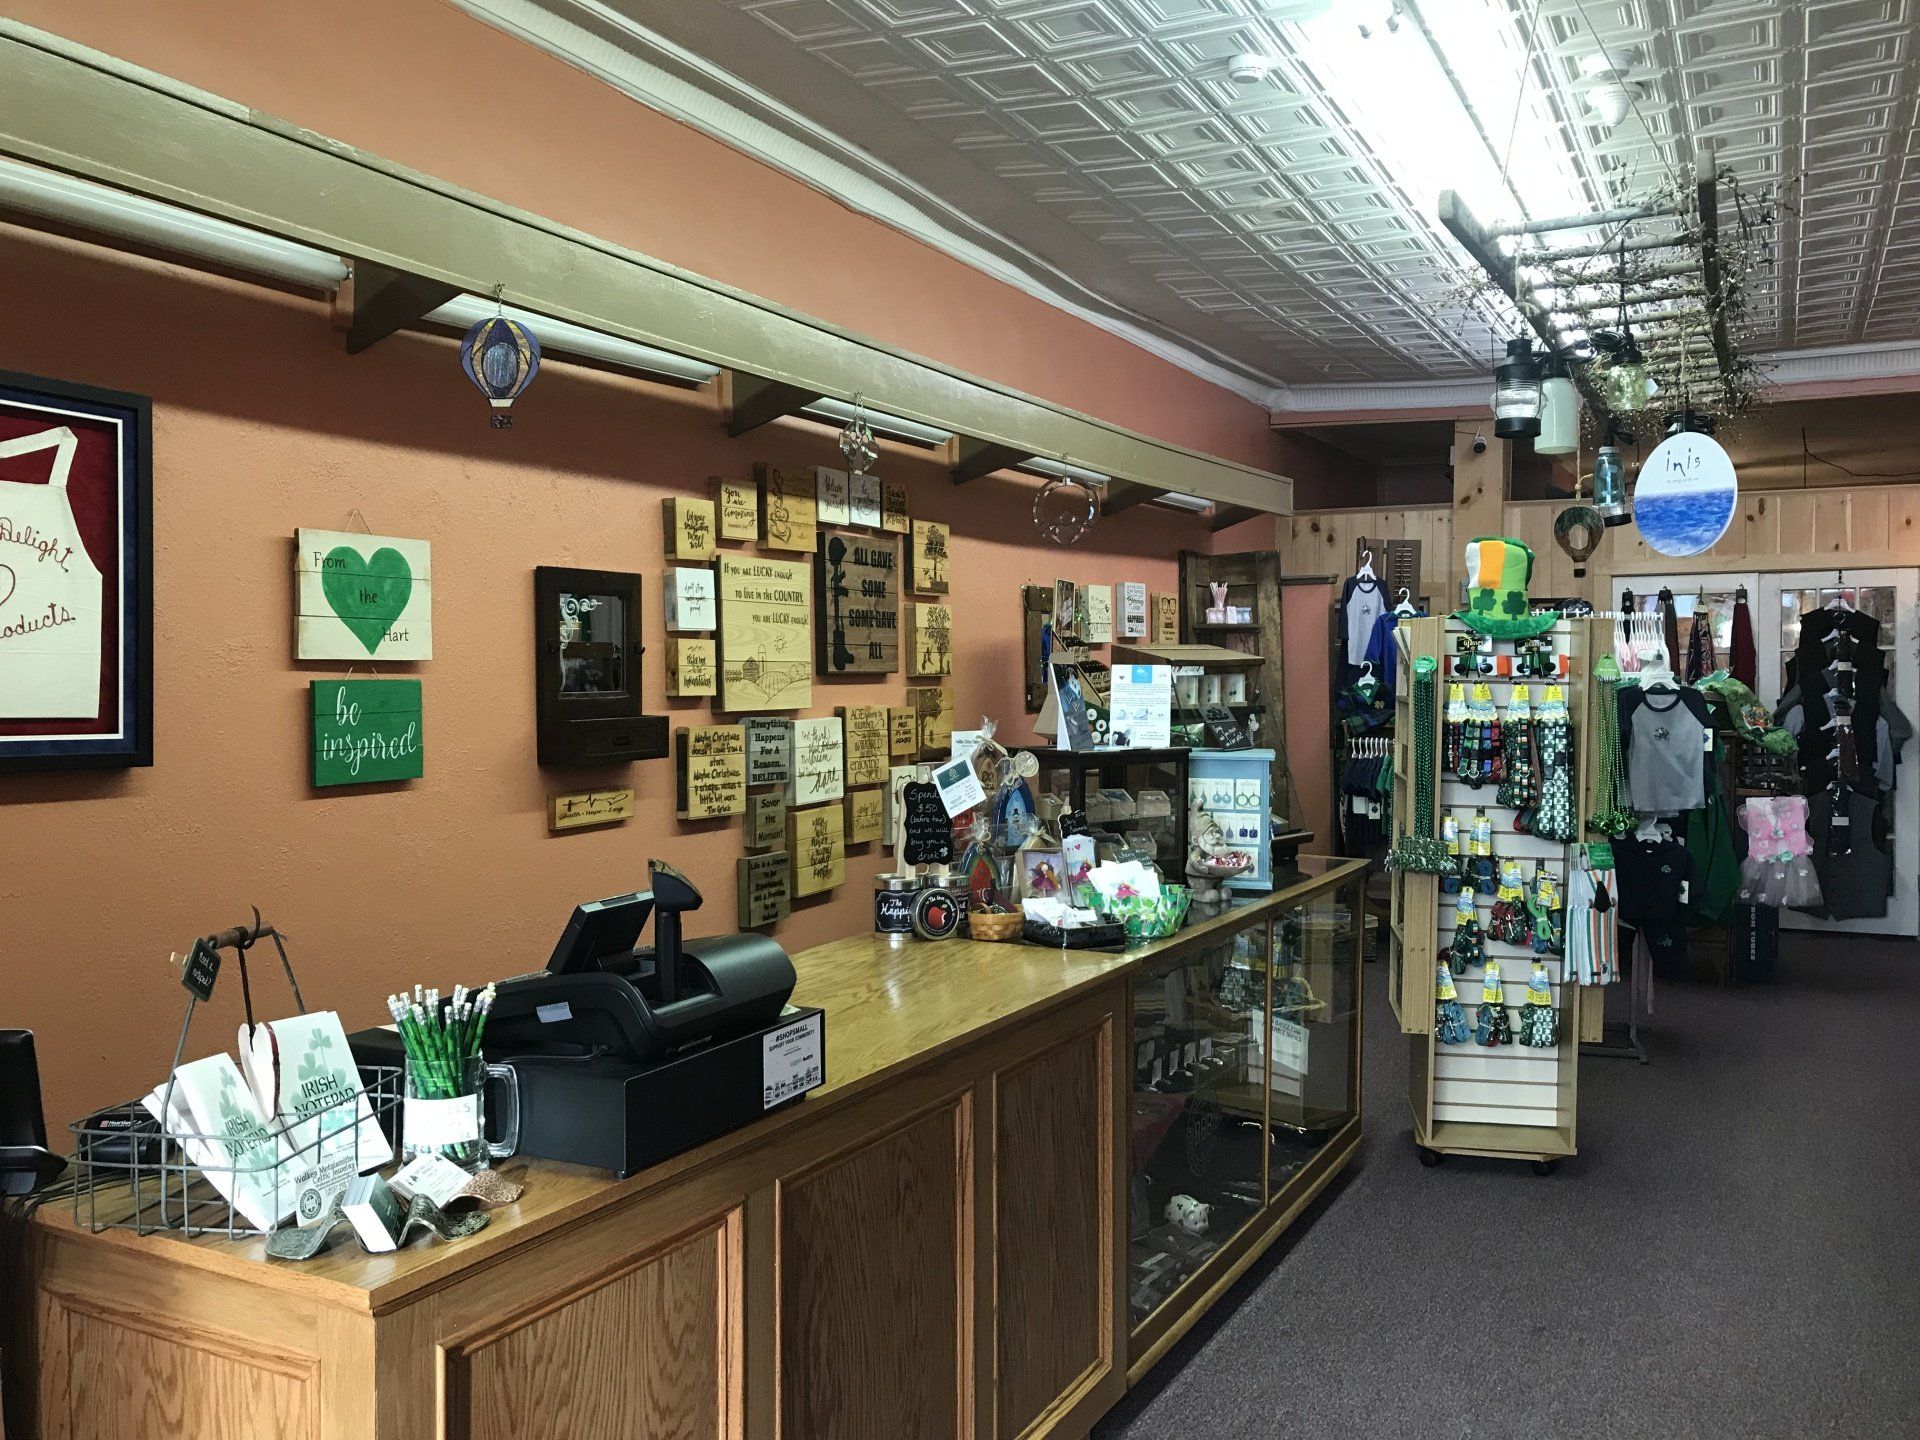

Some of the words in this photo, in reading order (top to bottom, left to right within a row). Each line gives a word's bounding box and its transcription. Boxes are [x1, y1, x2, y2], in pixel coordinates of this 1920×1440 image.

[313, 551, 346, 569] From
[854, 547, 868, 565] ALL
[870, 549, 893, 569] GAVE
[753, 566, 773, 577] LUCKY
[359, 587, 378, 604] the
[861, 579, 886, 599] SOME
[0, 602, 76, 639] oducts
[772, 612, 790, 624] LUCKY
[849, 609, 874, 628] SOME
[875, 611, 897, 629] GAVE
[382, 627, 409, 642] Hart
[869, 642, 883, 660] ALL
[336, 686, 361, 726] be
[750, 719, 789, 733] Everything
[694, 731, 711, 743] Maybe
[712, 731, 740, 742] Christmas
[754, 733, 785, 743] Happens
[323, 721, 417, 776] inspired
[760, 746, 773, 755] For
[775, 746, 780, 754] A
[693, 769, 711, 782] Maybe
[908, 788, 940, 803] Spend
[761, 799, 780, 809] Savor
[916, 804, 938, 813] $50
[757, 829, 784, 842] Moment
[935, 826, 950, 834] will
[910, 838, 924, 850] buy
[917, 851, 940, 861] drink
[889, 899, 902, 907] The
[880, 903, 909, 919] Happi
[768, 1041, 785, 1052] SUPPORT
[785, 1036, 795, 1045] YOUR
[794, 1029, 815, 1042] COMMUNITY
[776, 1024, 808, 1042] #SHOPSMALL
[301, 1073, 339, 1099] IRISH
[293, 1087, 356, 1121] NOTEPAD
[224, 1114, 252, 1136] IRISH
[224, 1127, 272, 1159] NOTEPAD
